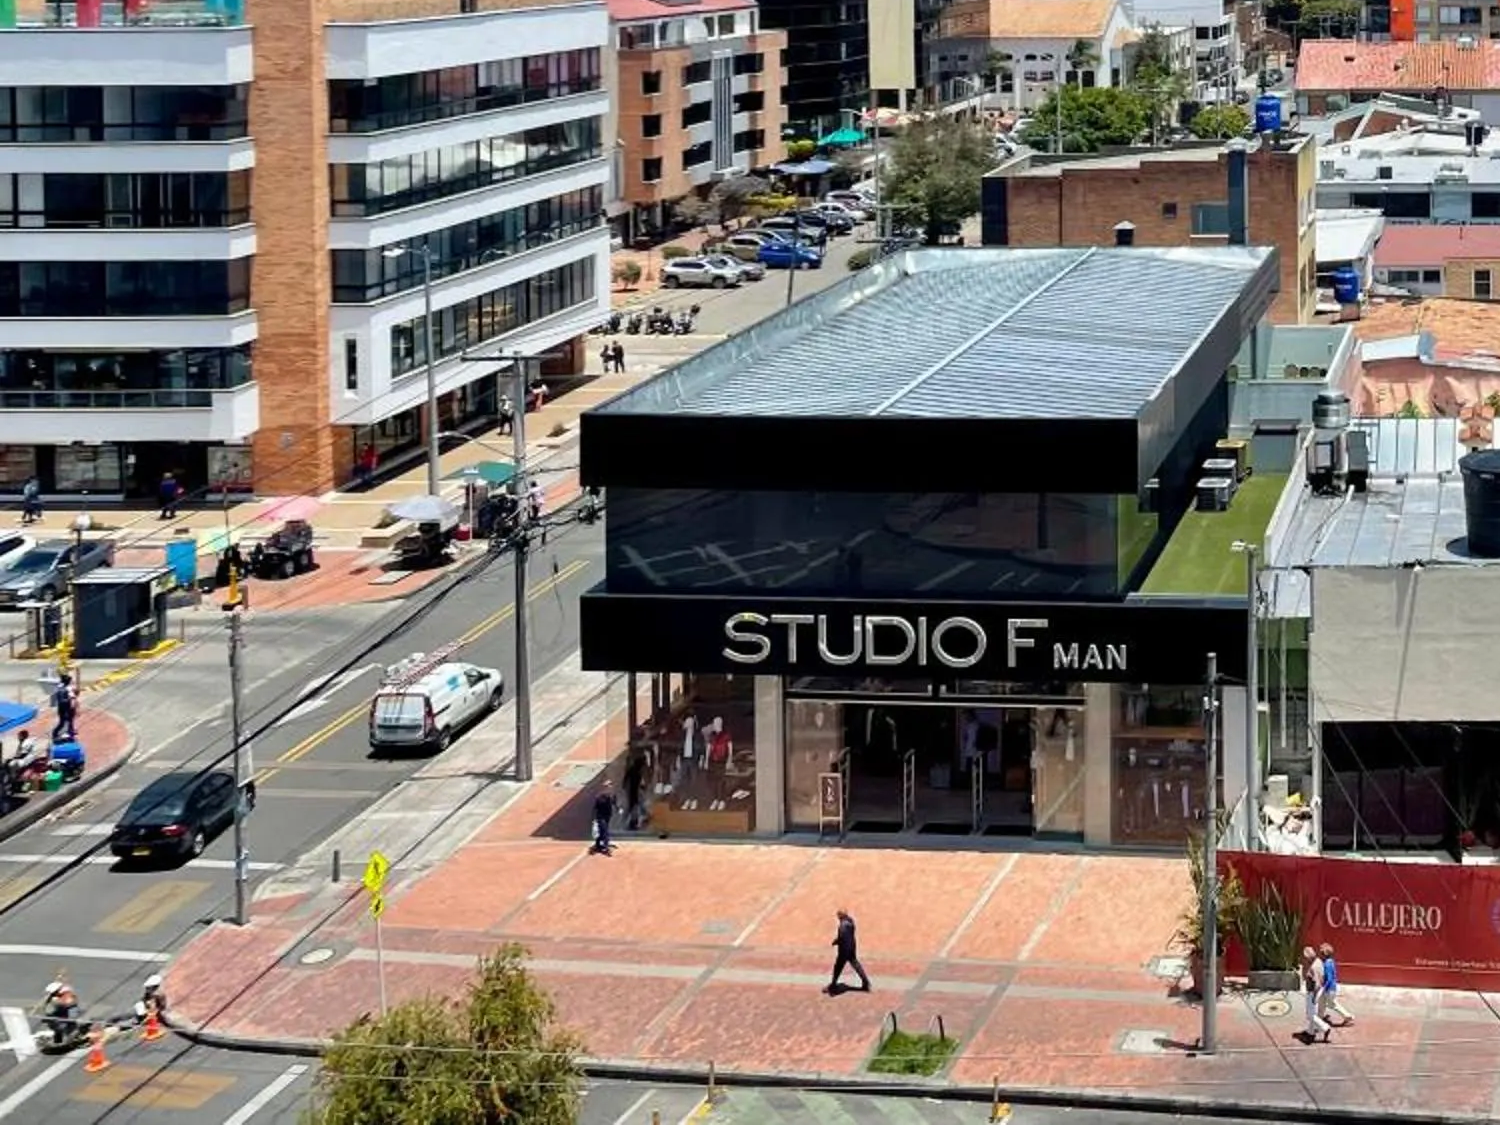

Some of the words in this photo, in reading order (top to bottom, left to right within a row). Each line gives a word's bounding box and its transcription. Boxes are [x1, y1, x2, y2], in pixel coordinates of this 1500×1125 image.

[722, 612, 987, 668] STUDIO
[1007, 618, 1048, 667] F
[1053, 642, 1127, 670] MAN
[1325, 896, 1441, 934] CALLEJERO
